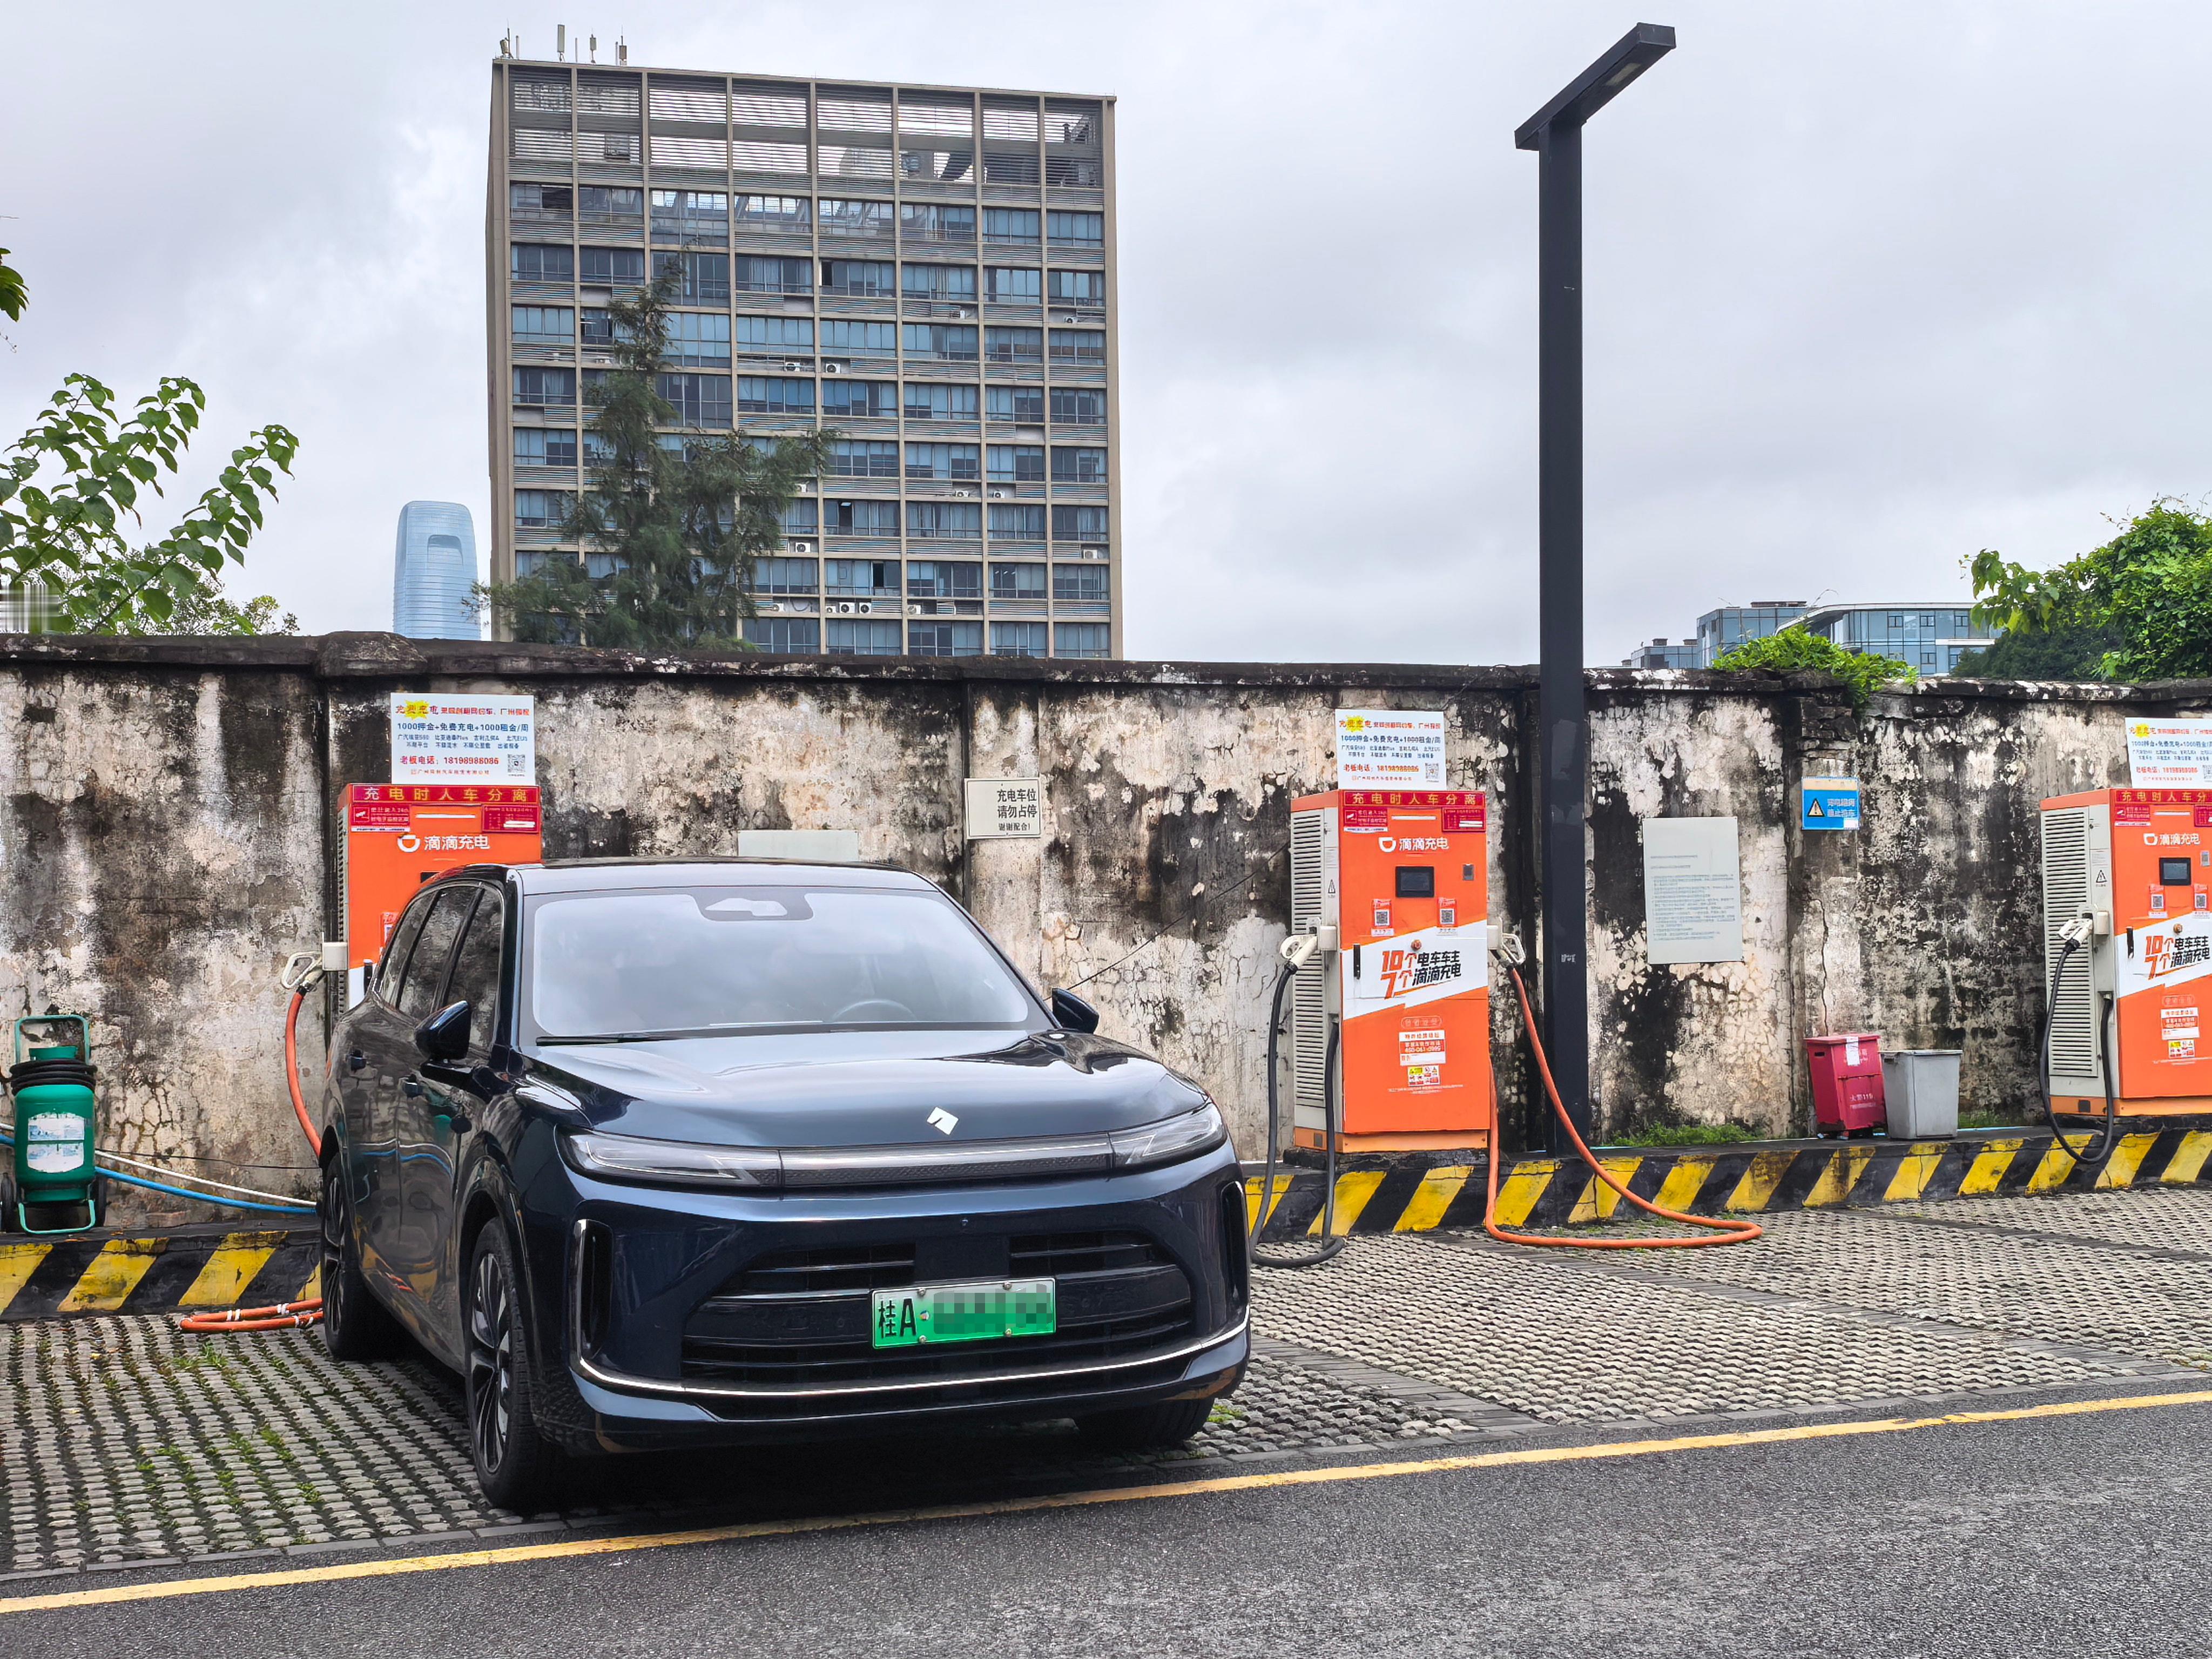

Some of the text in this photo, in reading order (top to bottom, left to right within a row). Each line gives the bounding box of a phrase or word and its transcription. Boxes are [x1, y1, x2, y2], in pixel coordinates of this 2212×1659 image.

[364, 787, 527, 801] 充电时人车分离
[997, 788, 1037, 802] 充电车位
[1352, 793, 1476, 805] 充电时人车分离
[997, 805, 1037, 818] 请勿占停
[424, 835, 490, 851] 滴滴充电
[1399, 837, 1449, 851] 滴滴充电
[2160, 833, 2201, 846] 滴滴充电
[1382, 950, 1460, 972] 10个电车车主
[1380, 963, 1461, 1000] 7个滴滴充电
